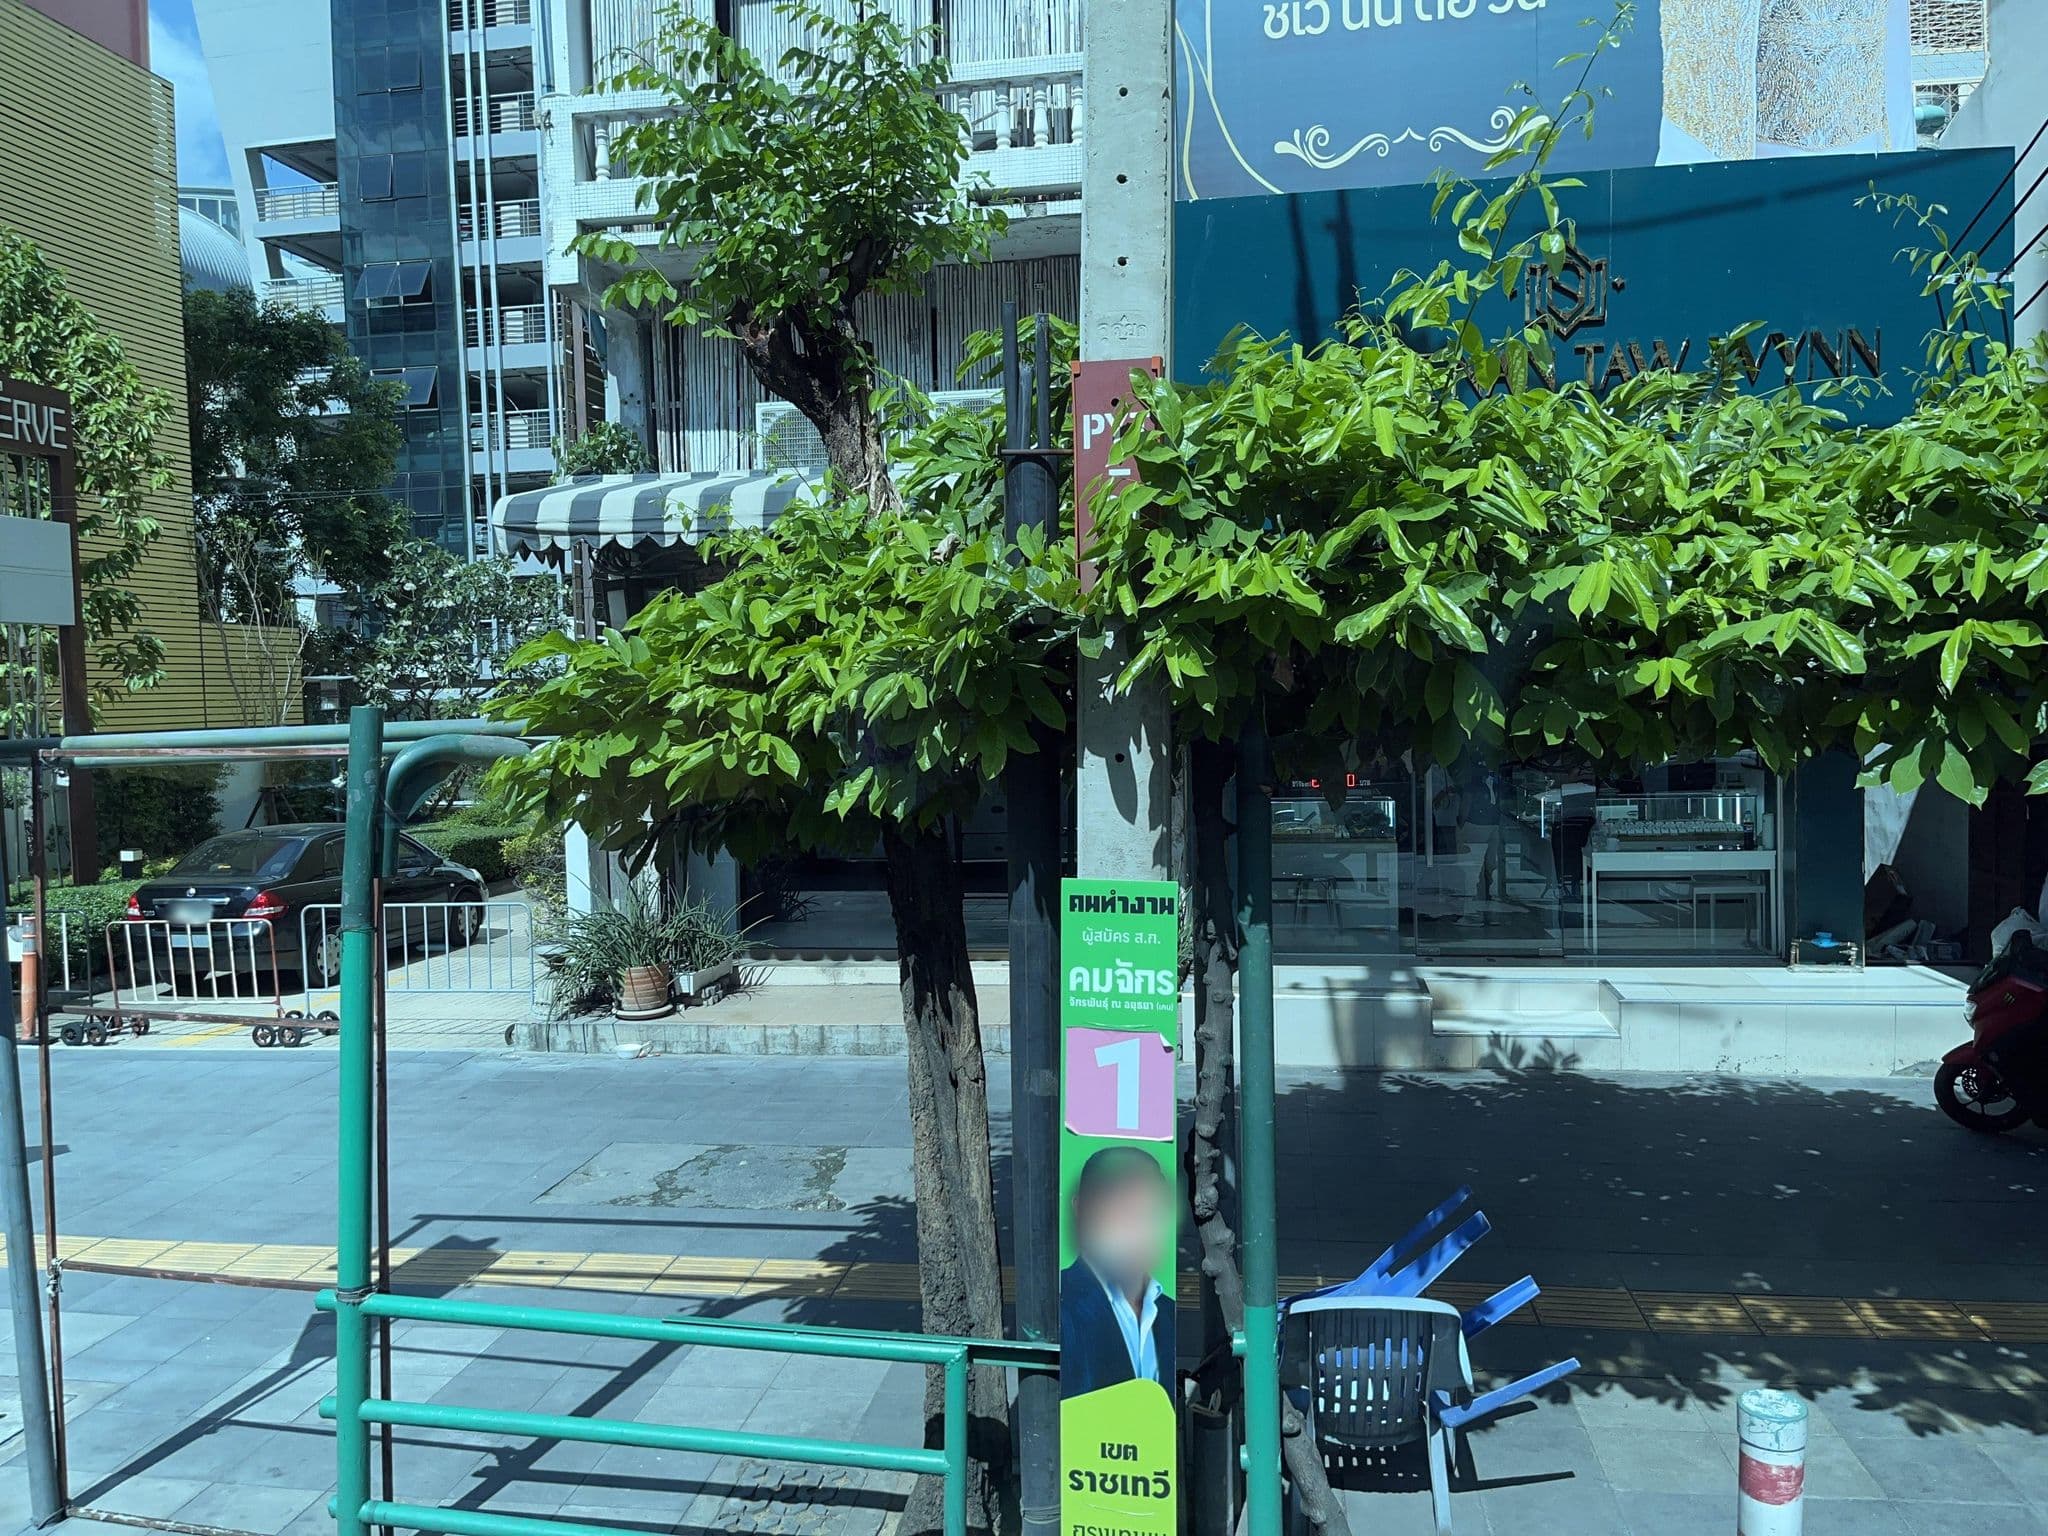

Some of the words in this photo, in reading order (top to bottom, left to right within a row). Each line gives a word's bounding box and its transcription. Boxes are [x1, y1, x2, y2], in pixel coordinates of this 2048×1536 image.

[1069, 889, 1175, 915] คนทำงาน
[1082, 927, 1130, 946] ผู้สมัคร
[1134, 931, 1161, 945] ส.ก.
[1069, 958, 1175, 996] คมจักร
[1094, 1038, 1140, 1130] 1
[1101, 1442, 1138, 1461] เขต
[1068, 1469, 1171, 1499] ราชเทวี
